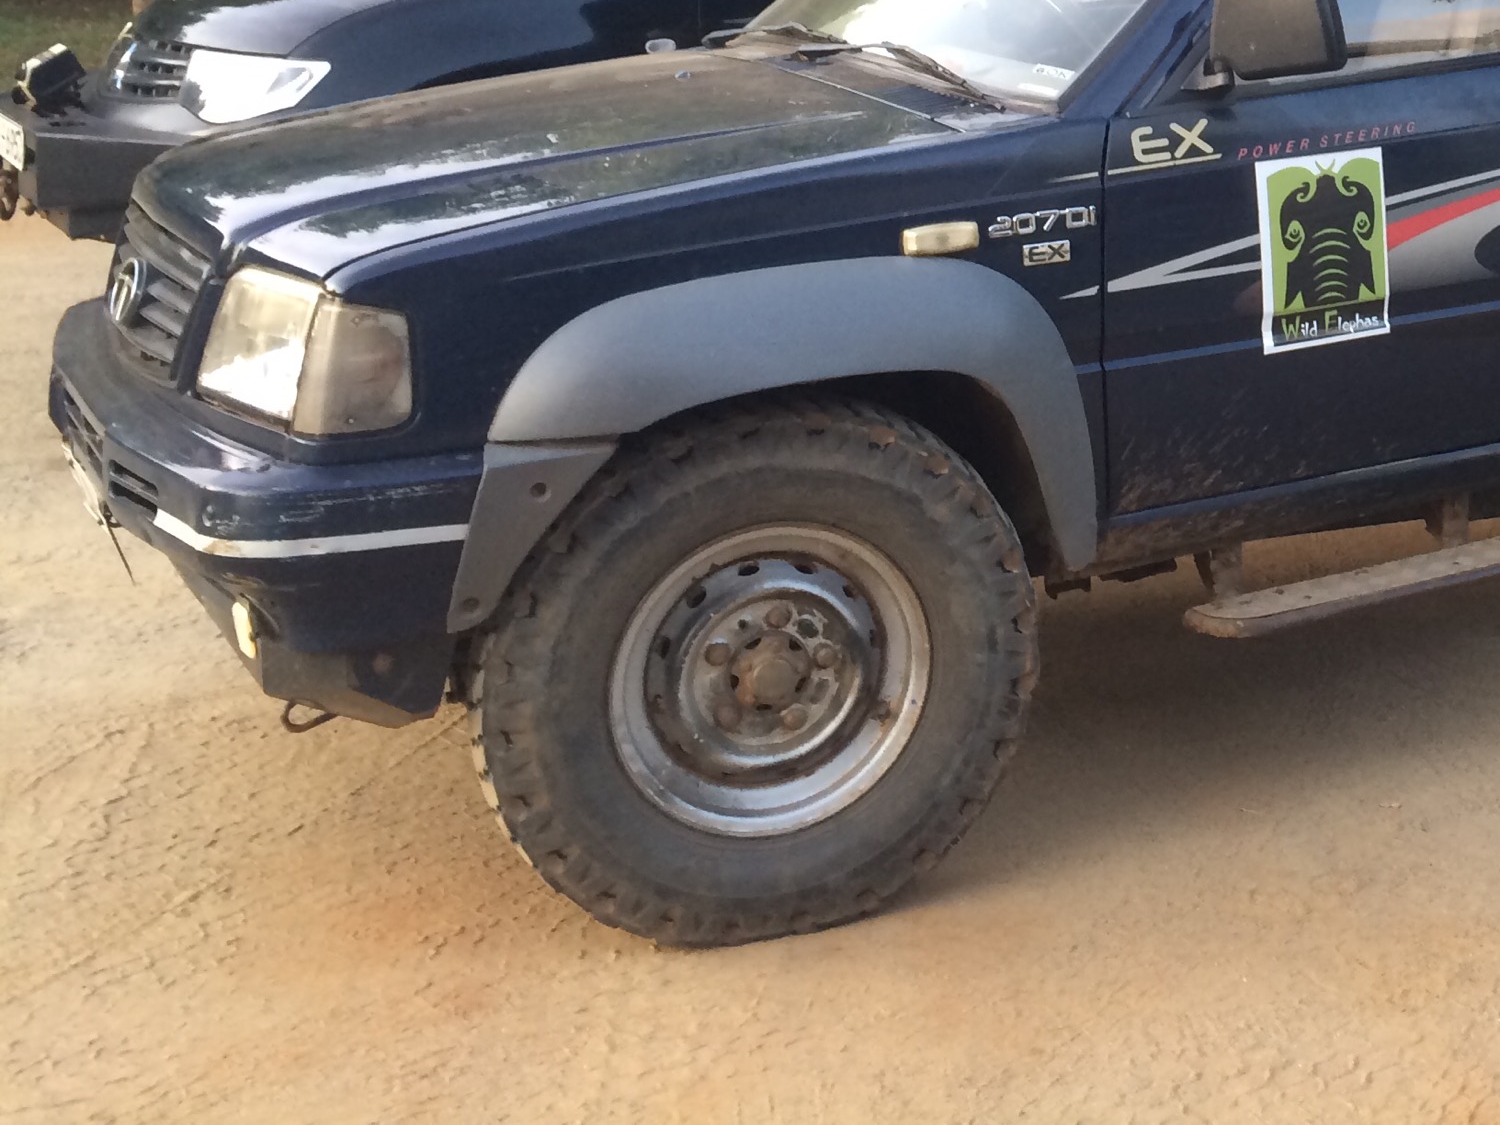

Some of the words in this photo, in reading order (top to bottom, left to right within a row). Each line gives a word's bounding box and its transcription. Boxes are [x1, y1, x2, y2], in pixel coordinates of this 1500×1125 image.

[1130, 118, 1214, 163] EX
[1238, 138, 1310, 160] POWER
[1319, 121, 1416, 148] STEERING
[1027, 242, 1066, 263] EX
[1281, 315, 1318, 341] Wild
